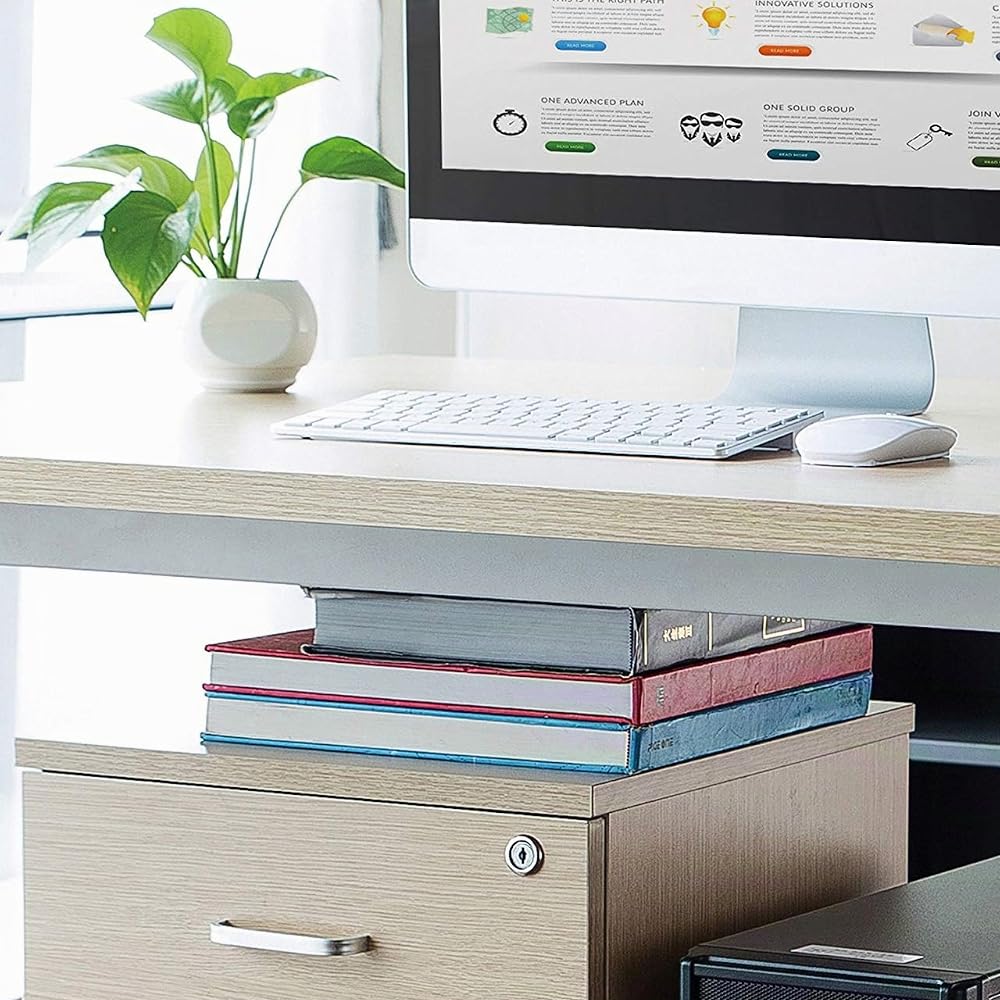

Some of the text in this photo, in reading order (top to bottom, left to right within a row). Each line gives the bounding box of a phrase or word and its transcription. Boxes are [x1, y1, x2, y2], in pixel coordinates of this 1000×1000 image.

[817, 1, 874, 9] SOLUTIONS
[563, 98, 617, 106] ADVANCED
[619, 99, 645, 107] PLAN
[787, 104, 816, 112] SOLID
[819, 105, 855, 113] GROUP
[968, 110, 992, 118] JOIN
